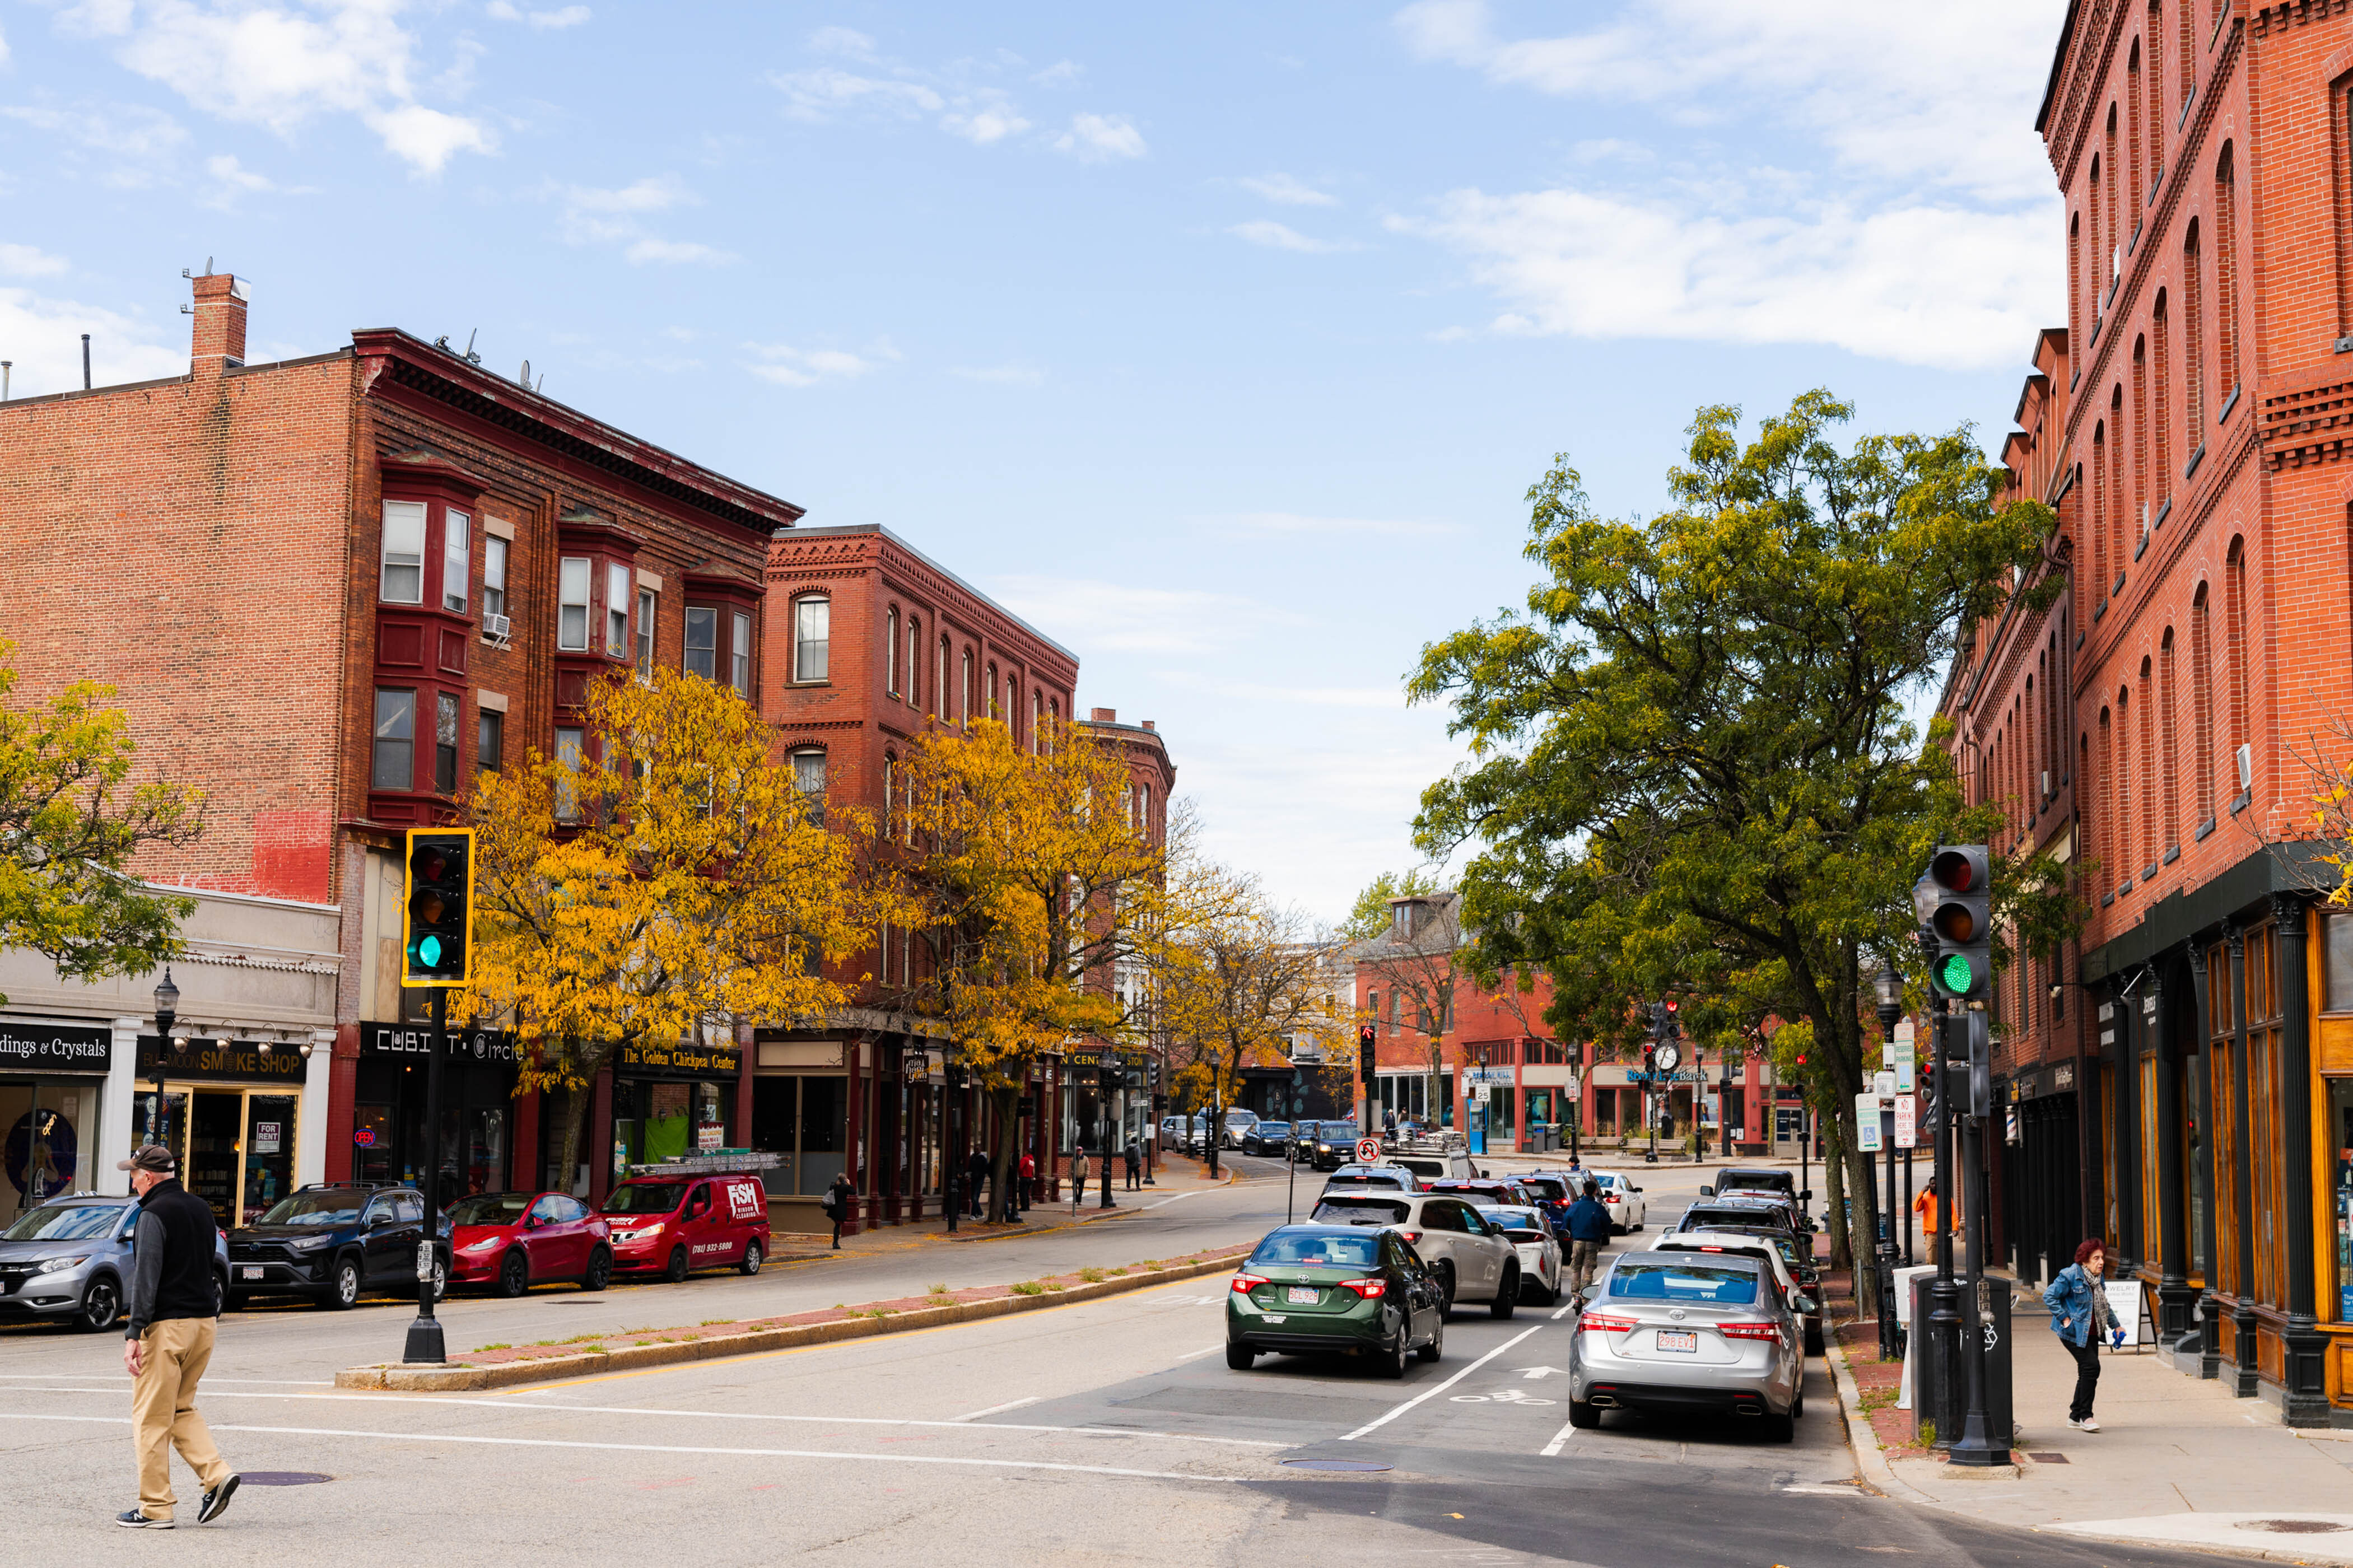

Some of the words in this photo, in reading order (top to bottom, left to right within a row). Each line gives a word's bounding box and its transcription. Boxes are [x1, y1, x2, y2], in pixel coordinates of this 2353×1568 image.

[40, 1042, 49, 1054] &
[52, 1038, 106, 1060] Crystals
[259, 1052, 300, 1074] SHOP
[624, 1048, 639, 1063] The
[642, 1049, 669, 1066] Golden
[673, 1052, 709, 1071] Chickpea
[712, 1054, 736, 1070] Center
[1900, 1100, 1909, 1110] NO
[1896, 1111, 1913, 1121] PARKING
[356, 1132, 374, 1143] OPEN
[692, 1244, 705, 1254] (781)
[707, 1242, 733, 1252] 932-5800
[1290, 1290, 1302, 1299] 5CL
[1304, 1291, 1317, 1300] 928
[1659, 1336, 1676, 1347] 298
